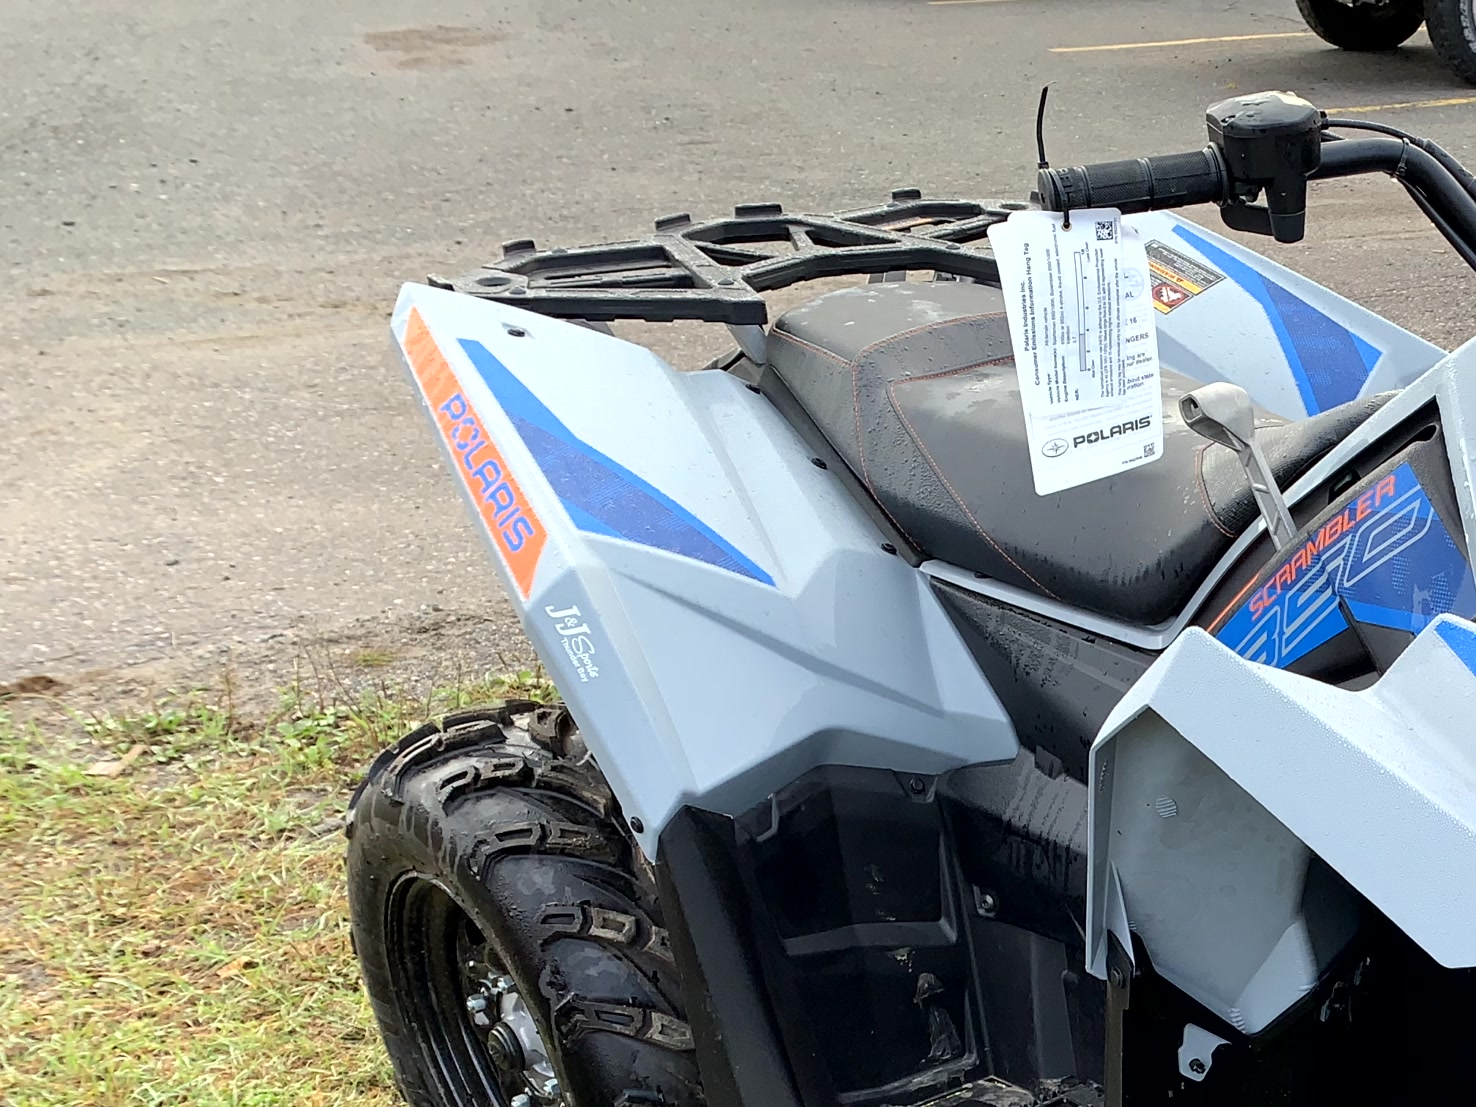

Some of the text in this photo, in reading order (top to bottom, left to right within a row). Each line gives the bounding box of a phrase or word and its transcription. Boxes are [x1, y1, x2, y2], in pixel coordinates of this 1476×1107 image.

[1073, 415, 1151, 448] POLARIS
[439, 392, 534, 553] POLARIS
[1249, 475, 1396, 621] SCRAMBLER
[545, 605, 599, 677] J&J Sports
[561, 637, 589, 682] Thunder Bay
